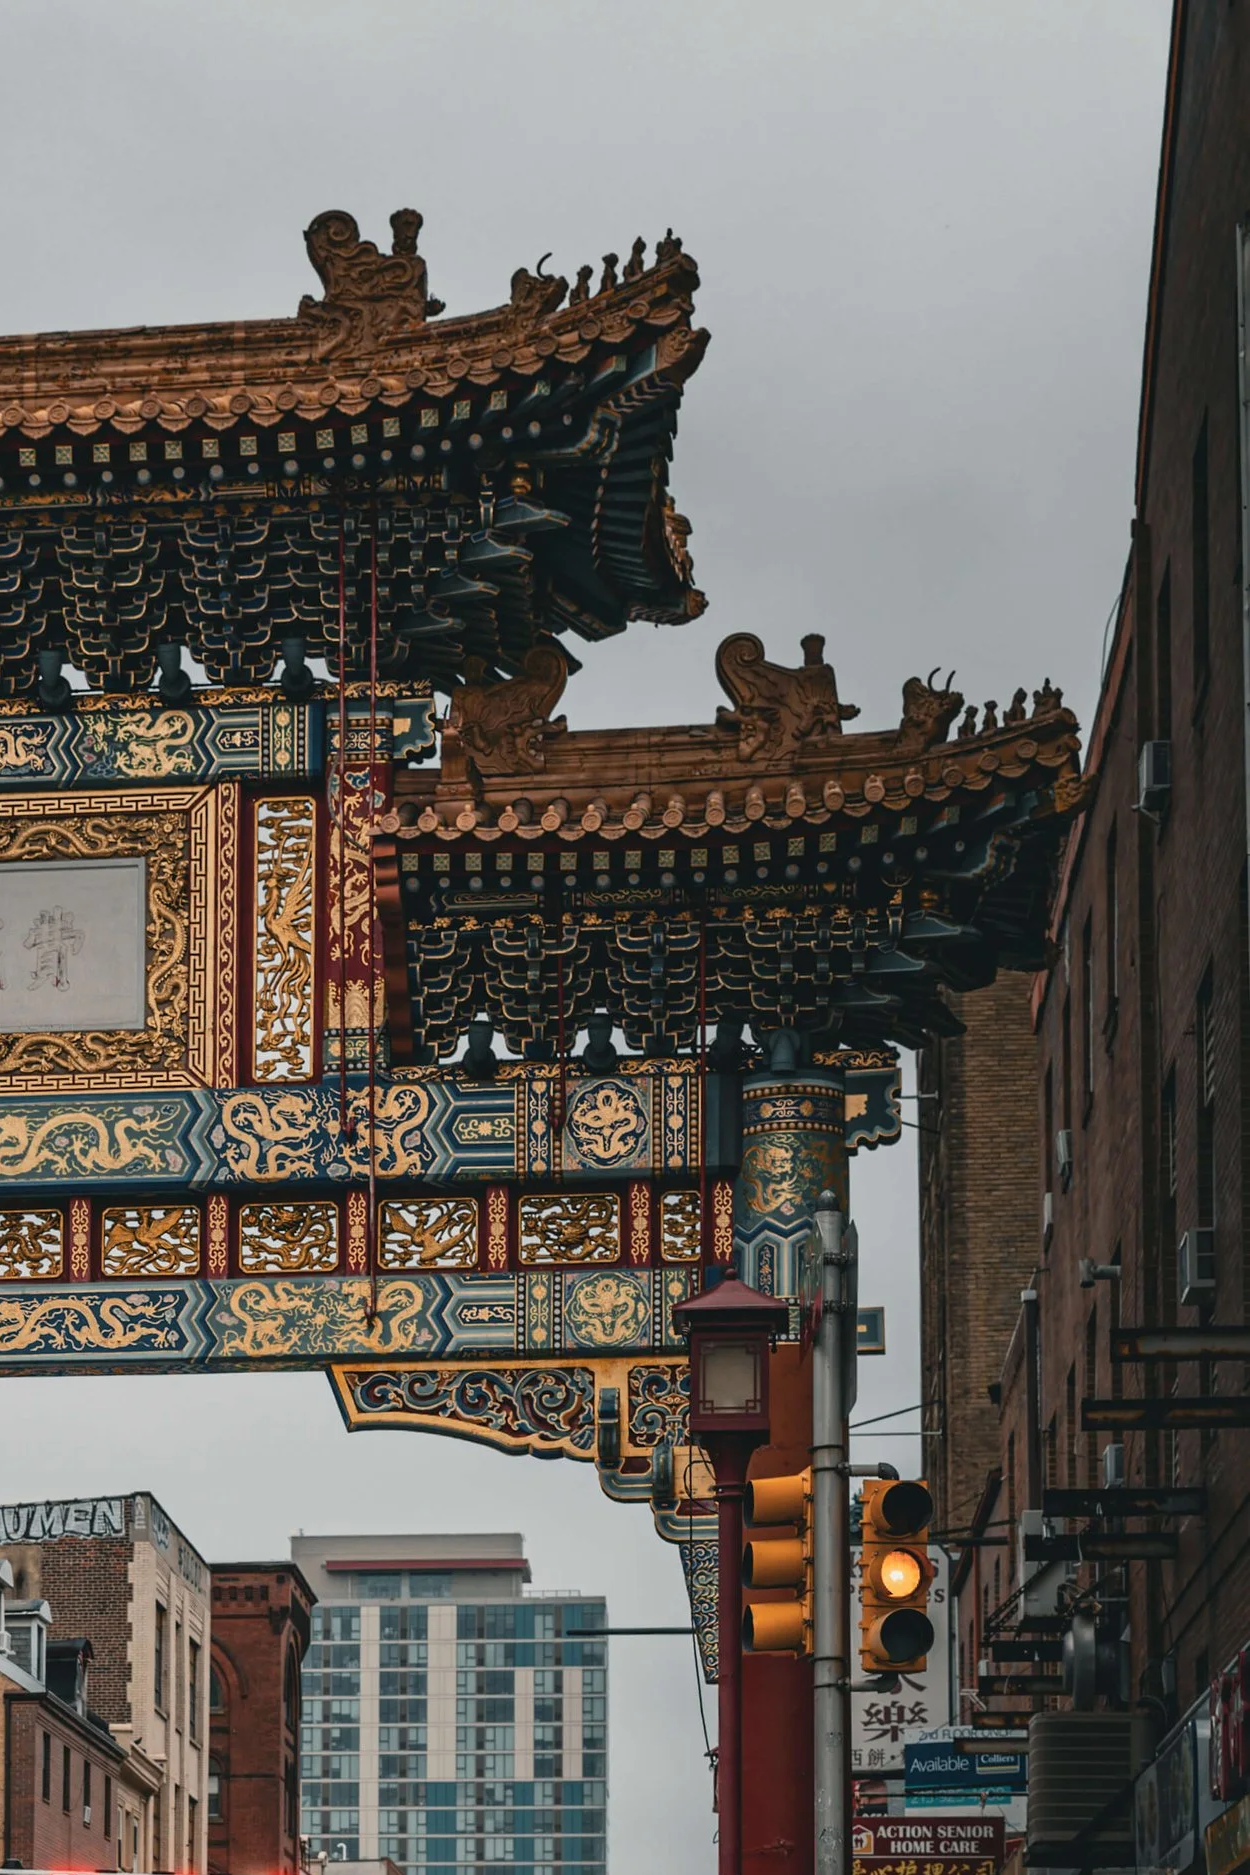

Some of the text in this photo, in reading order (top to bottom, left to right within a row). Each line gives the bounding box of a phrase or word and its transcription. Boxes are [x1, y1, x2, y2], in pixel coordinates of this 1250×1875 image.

[910, 1754, 969, 1774] Available
[980, 1754, 1015, 1764] Colliers
[876, 1825, 994, 1839] ACTION SENIOR
[890, 1841, 980, 1854] HOME CARE
